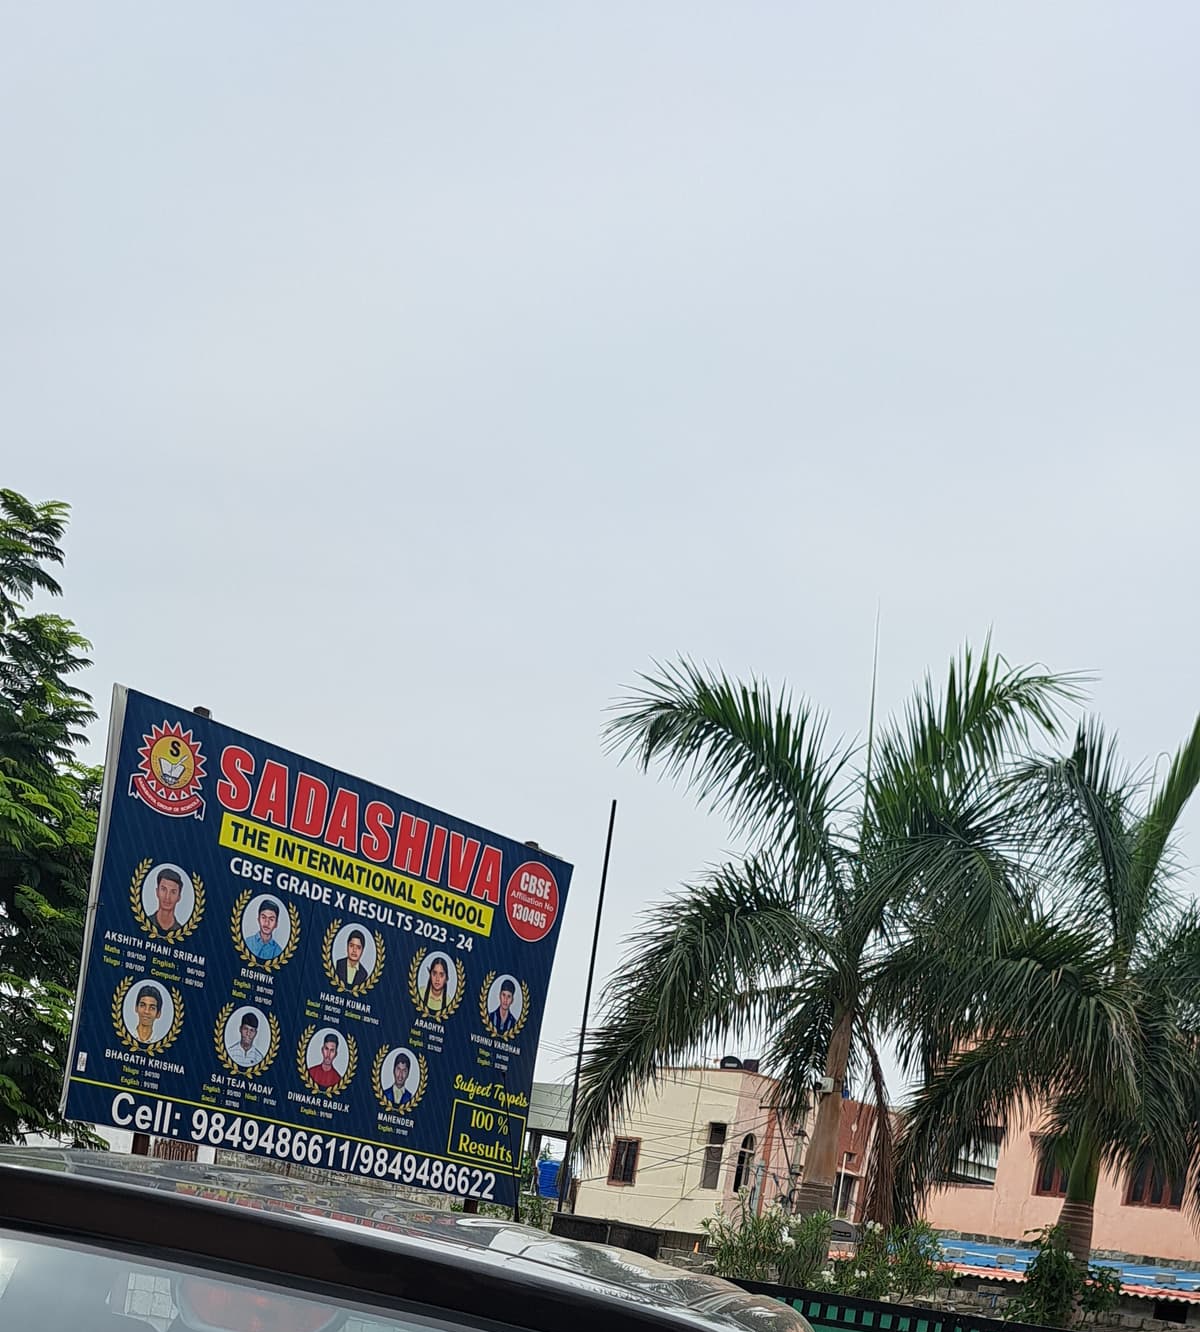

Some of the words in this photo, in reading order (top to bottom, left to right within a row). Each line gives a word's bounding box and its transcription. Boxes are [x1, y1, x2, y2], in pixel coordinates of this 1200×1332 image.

[169, 740, 181, 757] S
[216, 745, 503, 905] SADASHIVA
[230, 820, 271, 853] THE
[274, 837, 416, 904] INTERNATIONAL
[421, 889, 486, 928] SCHOOL
[520, 871, 552, 900] CBSE
[230, 857, 274, 885] CBSE
[276, 872, 333, 905] GRADE
[333, 890, 347, 910] X
[348, 896, 413, 932] RESULTS
[414, 919, 448, 943] 2023
[456, 934, 473, 952] 24
[511, 889, 543, 908] Affiliation
[544, 902, 554, 912] No
[512, 903, 547, 929] 130495
[104, 930, 143, 949] AKSHITH
[145, 941, 171, 956] PHANI
[173, 949, 205, 966] SRIRAM
[150, 968, 181, 982] Computer
[152, 957, 175, 969] English
[240, 967, 274, 985] RISHWIK
[320, 991, 345, 1006] HARSH
[345, 999, 371, 1014] KUMAR
[414, 1018, 445, 1034] ARADHYA
[470, 1033, 492, 1047] VISHNU
[493, 1040, 521, 1056] VARDHAN
[105, 1048, 146, 1066] BHAGATH
[148, 1058, 185, 1075] KRISHNA
[211, 1073, 225, 1085] SAI
[226, 1077, 246, 1090] TEJA
[248, 1081, 274, 1096] YADAV
[453, 1073, 493, 1100] Subject
[287, 1091, 321, 1107] DIWAKAR
[322, 1099, 350, 1113] BABU.K
[377, 1112, 415, 1128] MAHENDER
[470, 1109, 494, 1131] 100
[497, 1116, 509, 1136] %
[111, 1092, 181, 1136] Cell:
[190, 1108, 496, 1200] 9849486611/9849486622
[458, 1132, 513, 1163] Results
